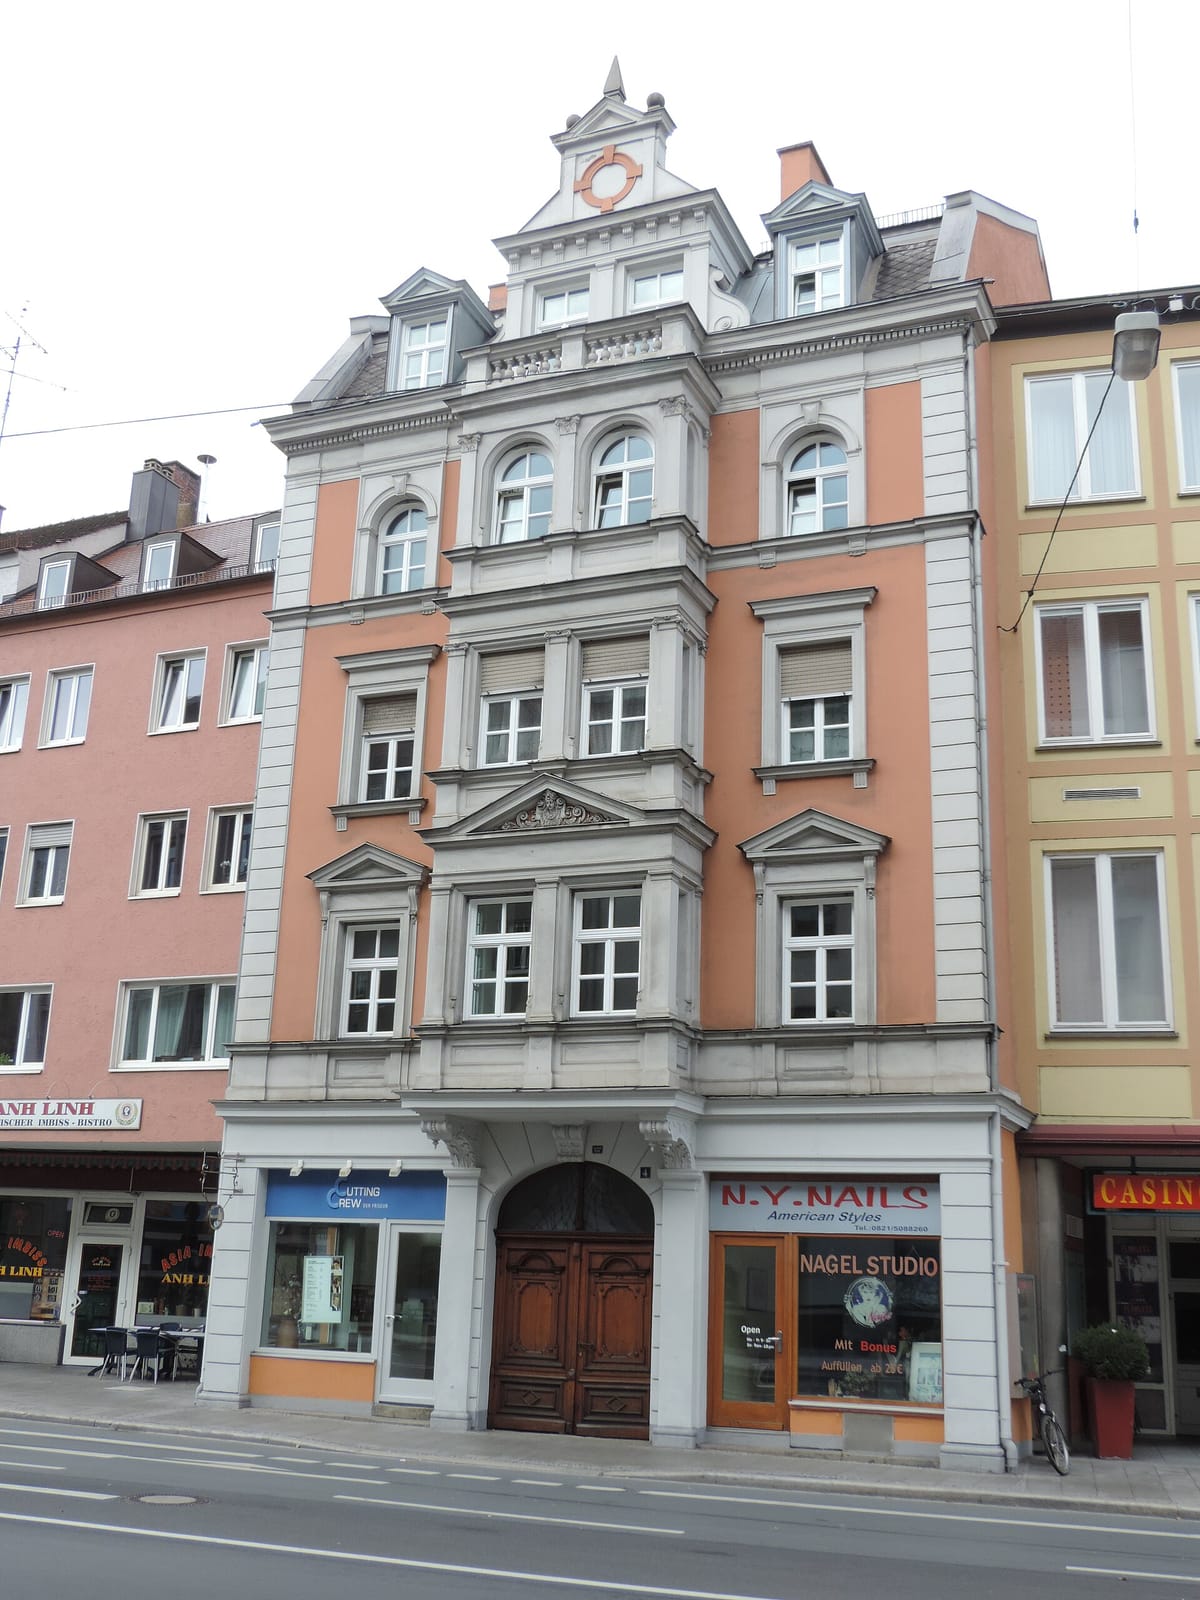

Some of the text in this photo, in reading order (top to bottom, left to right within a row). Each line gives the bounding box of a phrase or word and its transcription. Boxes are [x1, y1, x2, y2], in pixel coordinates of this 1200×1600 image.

[41, 1102, 95, 1116] LINH
[38, 1119, 70, 1127] IMBISS
[77, 1119, 113, 1127] BISTRO
[335, 1178, 381, 1197] CUTTING
[1100, 1177, 1200, 1206] CASIN
[326, 1187, 362, 1209] CREW
[767, 1210, 882, 1225] American Styles
[7, 1236, 48, 1267] IMBISS
[161, 1245, 192, 1272] ASIA
[9, 1265, 43, 1278] LINH
[800, 1254, 938, 1277] NAGEL STUDIO
[161, 1273, 194, 1285] ANH
[740, 1324, 761, 1335] Open
[860, 1340, 897, 1353] Bonus
[870, 1362, 881, 1374] ab
